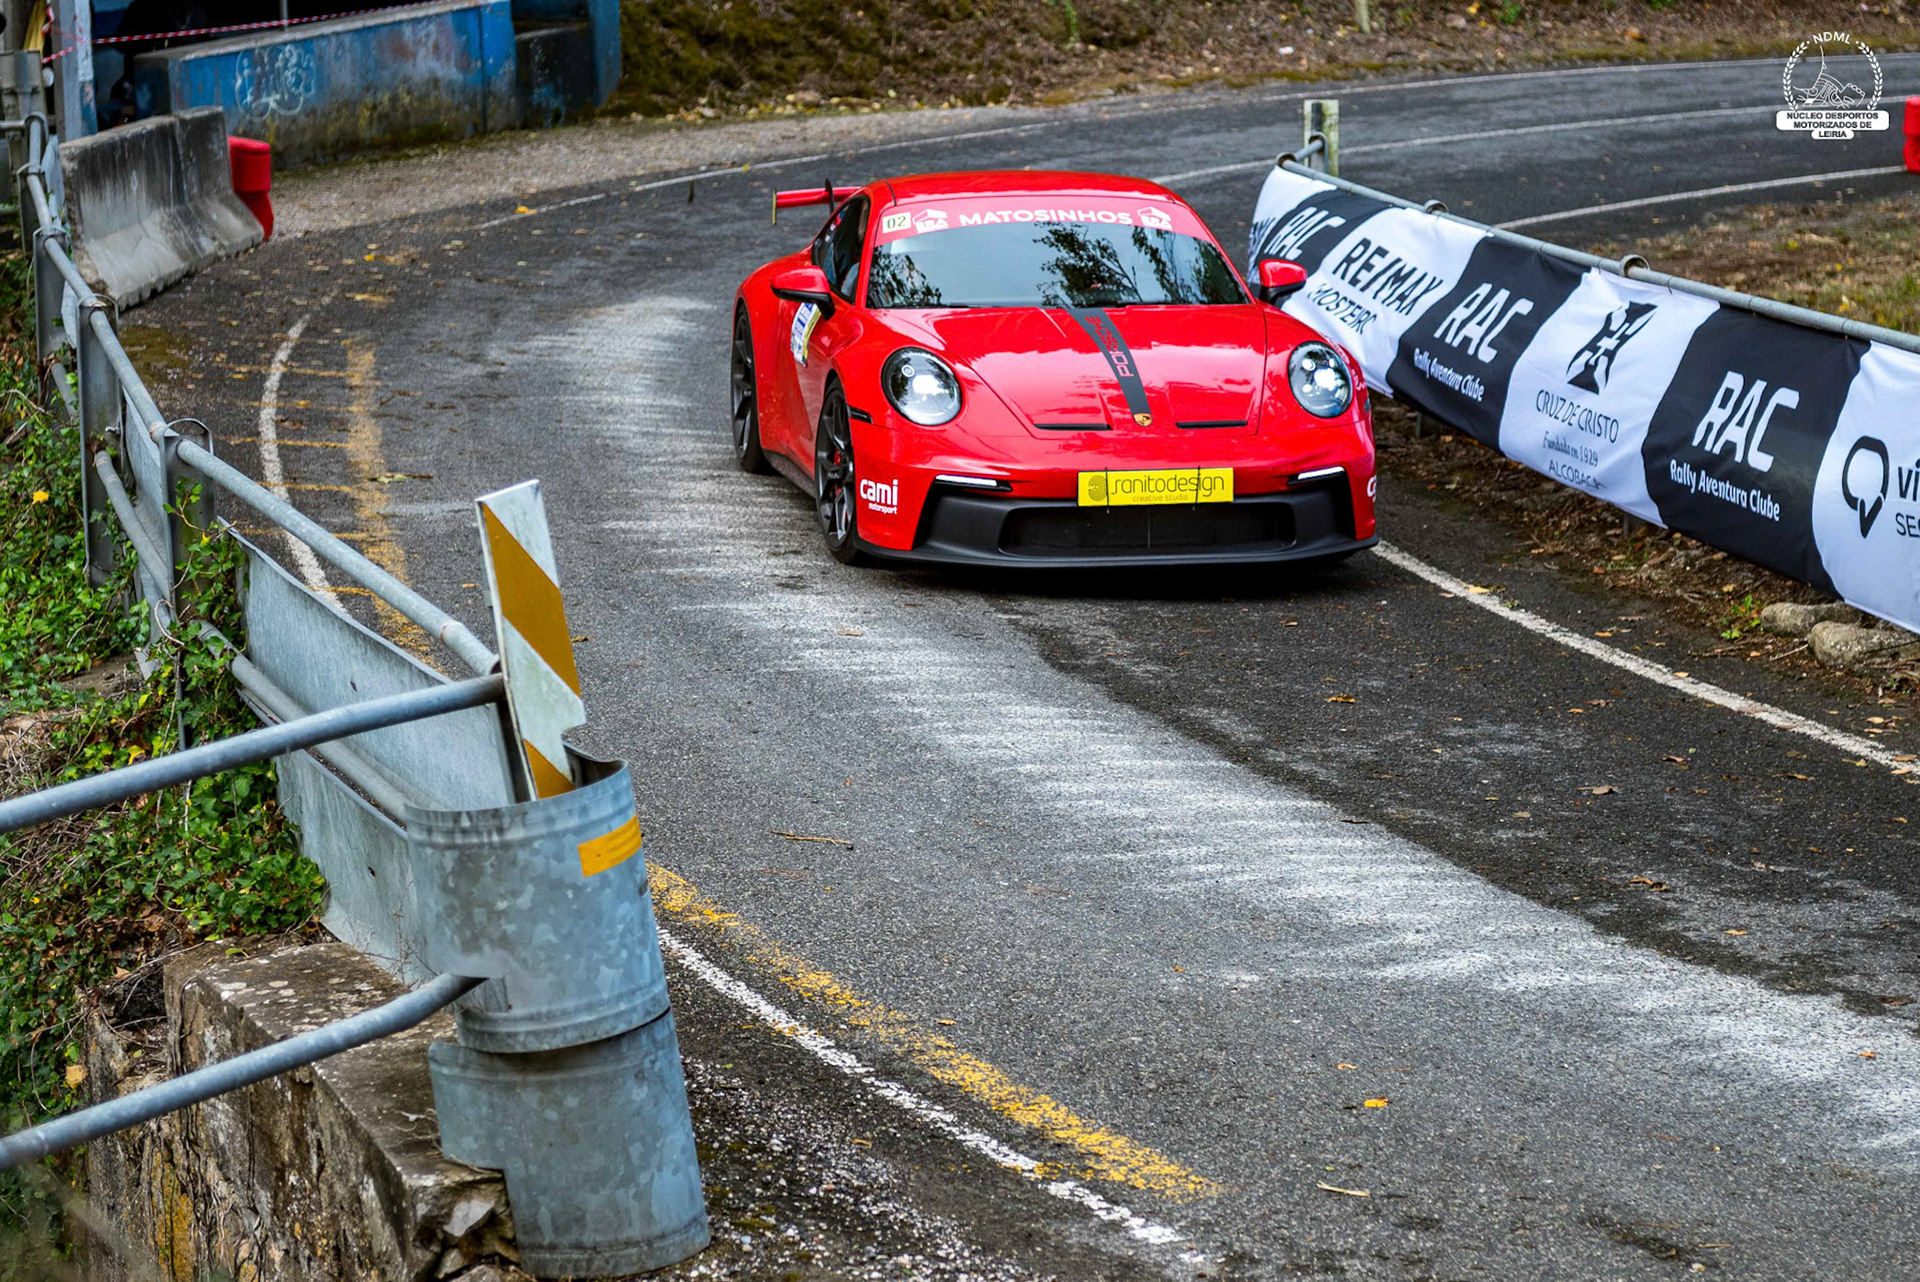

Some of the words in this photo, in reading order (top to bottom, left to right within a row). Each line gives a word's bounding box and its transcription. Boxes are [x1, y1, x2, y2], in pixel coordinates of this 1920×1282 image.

[887, 215, 906, 229] 02
[960, 209, 1133, 226] MATOSINHOS
[1263, 206, 1346, 261] RAC
[1332, 237, 1443, 316] RE/MAX
[1084, 315, 1135, 377] PORSCHE
[1433, 282, 1534, 363] RAC
[1414, 347, 1432, 379] Rally
[1430, 357, 1463, 391] Aventura
[1461, 374, 1485, 402] Clube
[1536, 389, 1566, 420] CRUZ
[1561, 401, 1580, 427] DE
[1577, 408, 1619, 444] CRISTO
[1691, 370, 1800, 473] RAC
[1580, 446, 1599, 467] 1929
[860, 478, 899, 506] cami
[868, 502, 898, 515] motorsport
[1132, 493, 1163, 503] creative
[1164, 492, 1189, 502] studio
[1670, 459, 1697, 494] Rally
[1698, 469, 1748, 509] Aventura
[1749, 488, 1780, 522] Clube
[1895, 512, 1920, 538] SE
